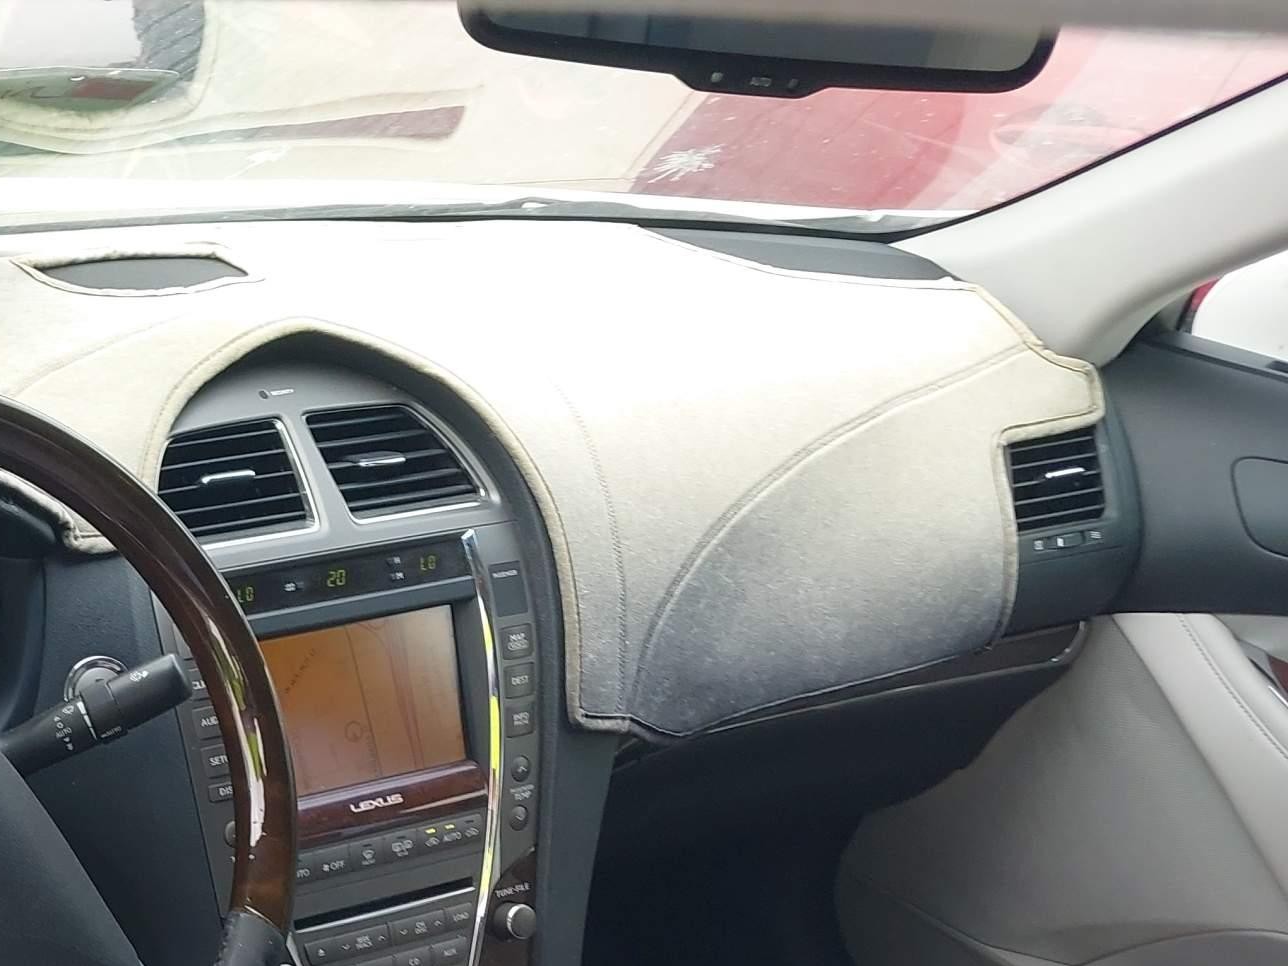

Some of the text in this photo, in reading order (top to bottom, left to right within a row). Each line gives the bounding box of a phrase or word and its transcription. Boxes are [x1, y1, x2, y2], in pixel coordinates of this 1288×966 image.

[327, 569, 346, 587] 20
[201, 715, 219, 727] AUD
[349, 793, 404, 813] LEXUS
